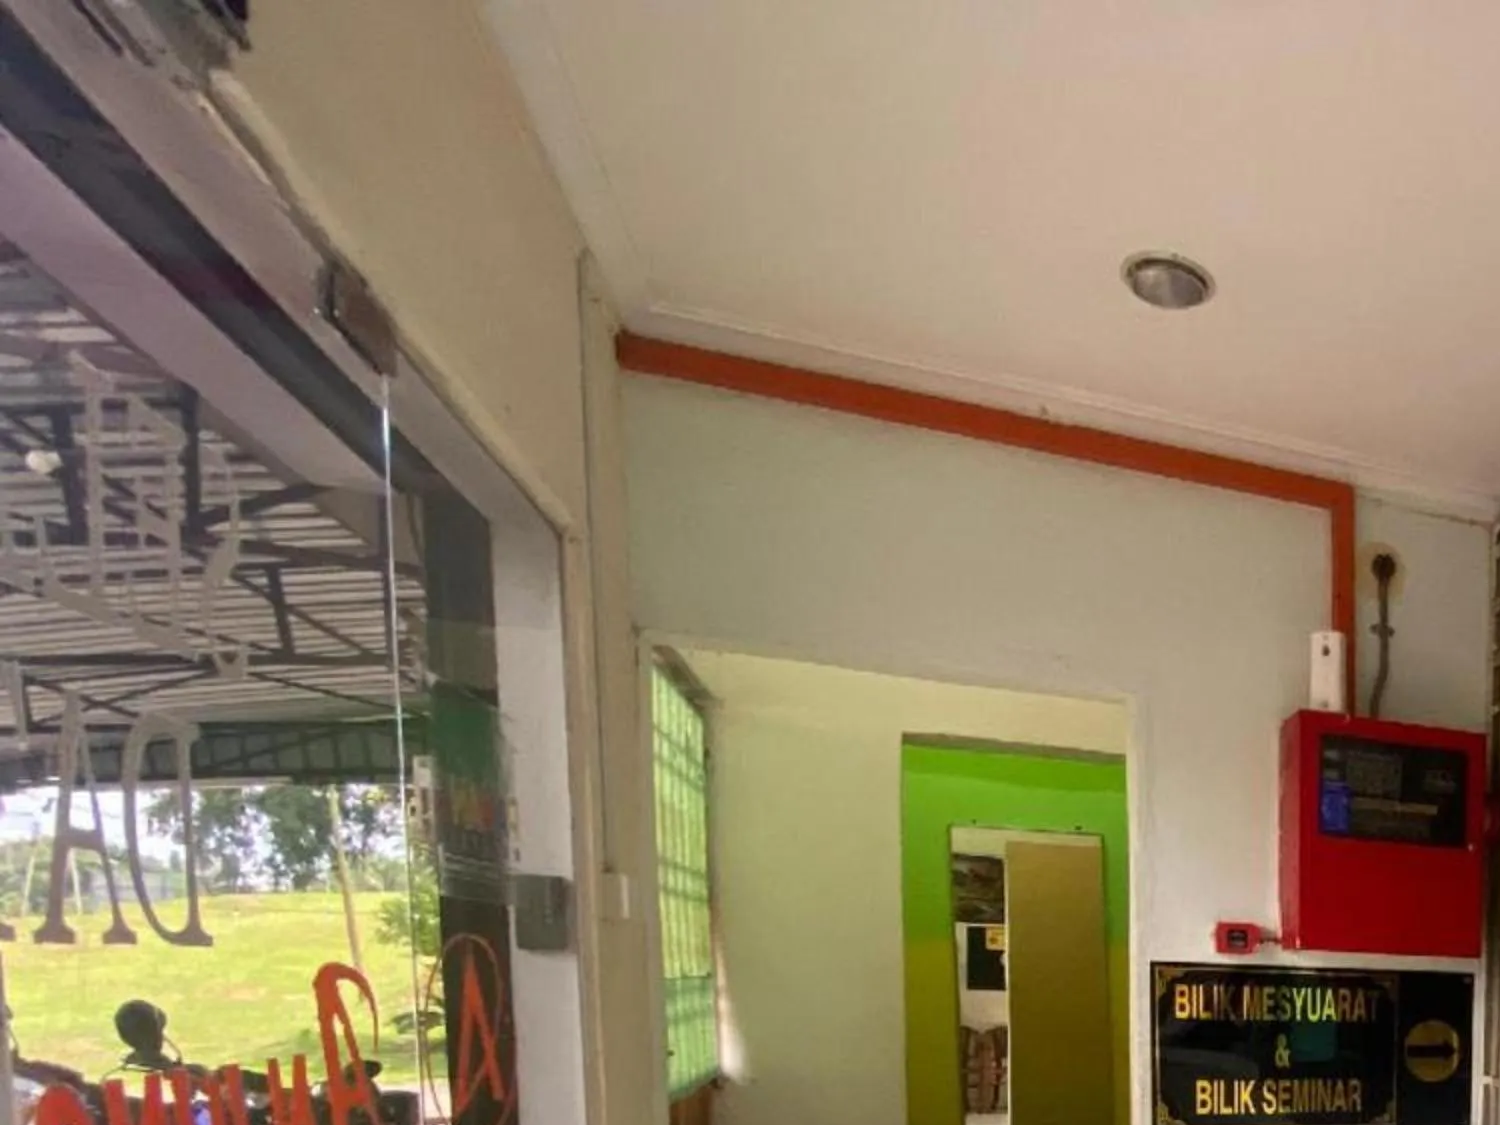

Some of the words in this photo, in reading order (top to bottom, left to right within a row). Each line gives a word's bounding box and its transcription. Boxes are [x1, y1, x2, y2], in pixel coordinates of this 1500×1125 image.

[1174, 983, 1238, 1020] BILIK
[1242, 986, 1381, 1022] MESYUARAT
[1274, 1034, 1291, 1068] &
[1195, 1079, 1257, 1115] BILIK
[1262, 1078, 1362, 1114] SEMINAR
